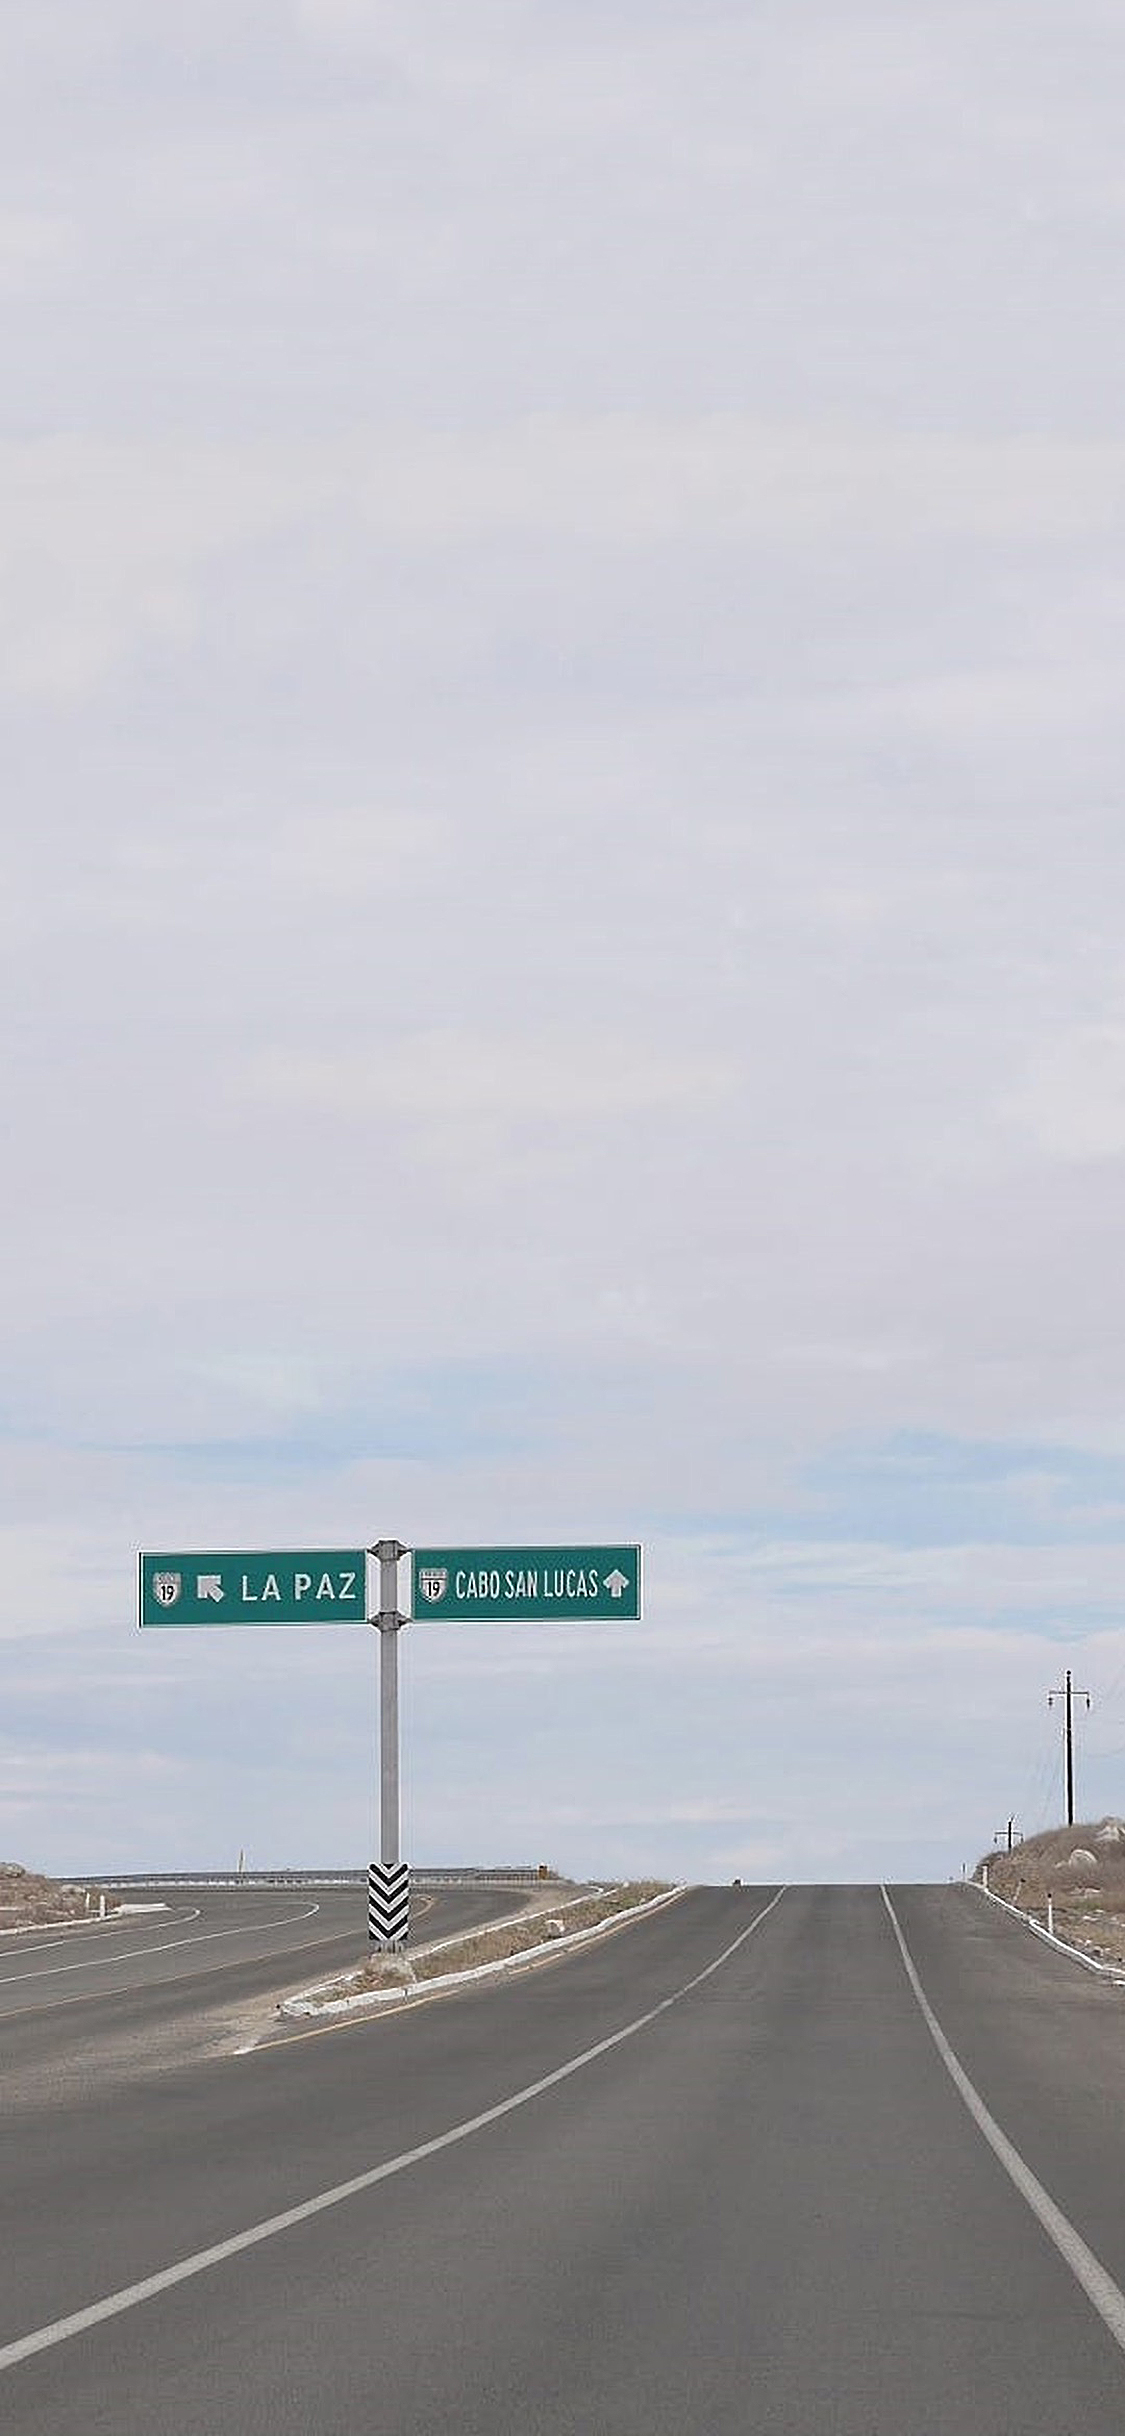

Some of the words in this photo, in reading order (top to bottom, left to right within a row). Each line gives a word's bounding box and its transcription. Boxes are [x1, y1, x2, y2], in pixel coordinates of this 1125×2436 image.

[161, 1585, 175, 1601] 19
[241, 1574, 281, 1602] LA
[294, 1572, 356, 1600] PAZ
[427, 1581, 440, 1597] 19
[456, 1570, 500, 1599] CABO
[505, 1570, 538, 1598] SAN
[544, 1569, 598, 1598] LUCAS
